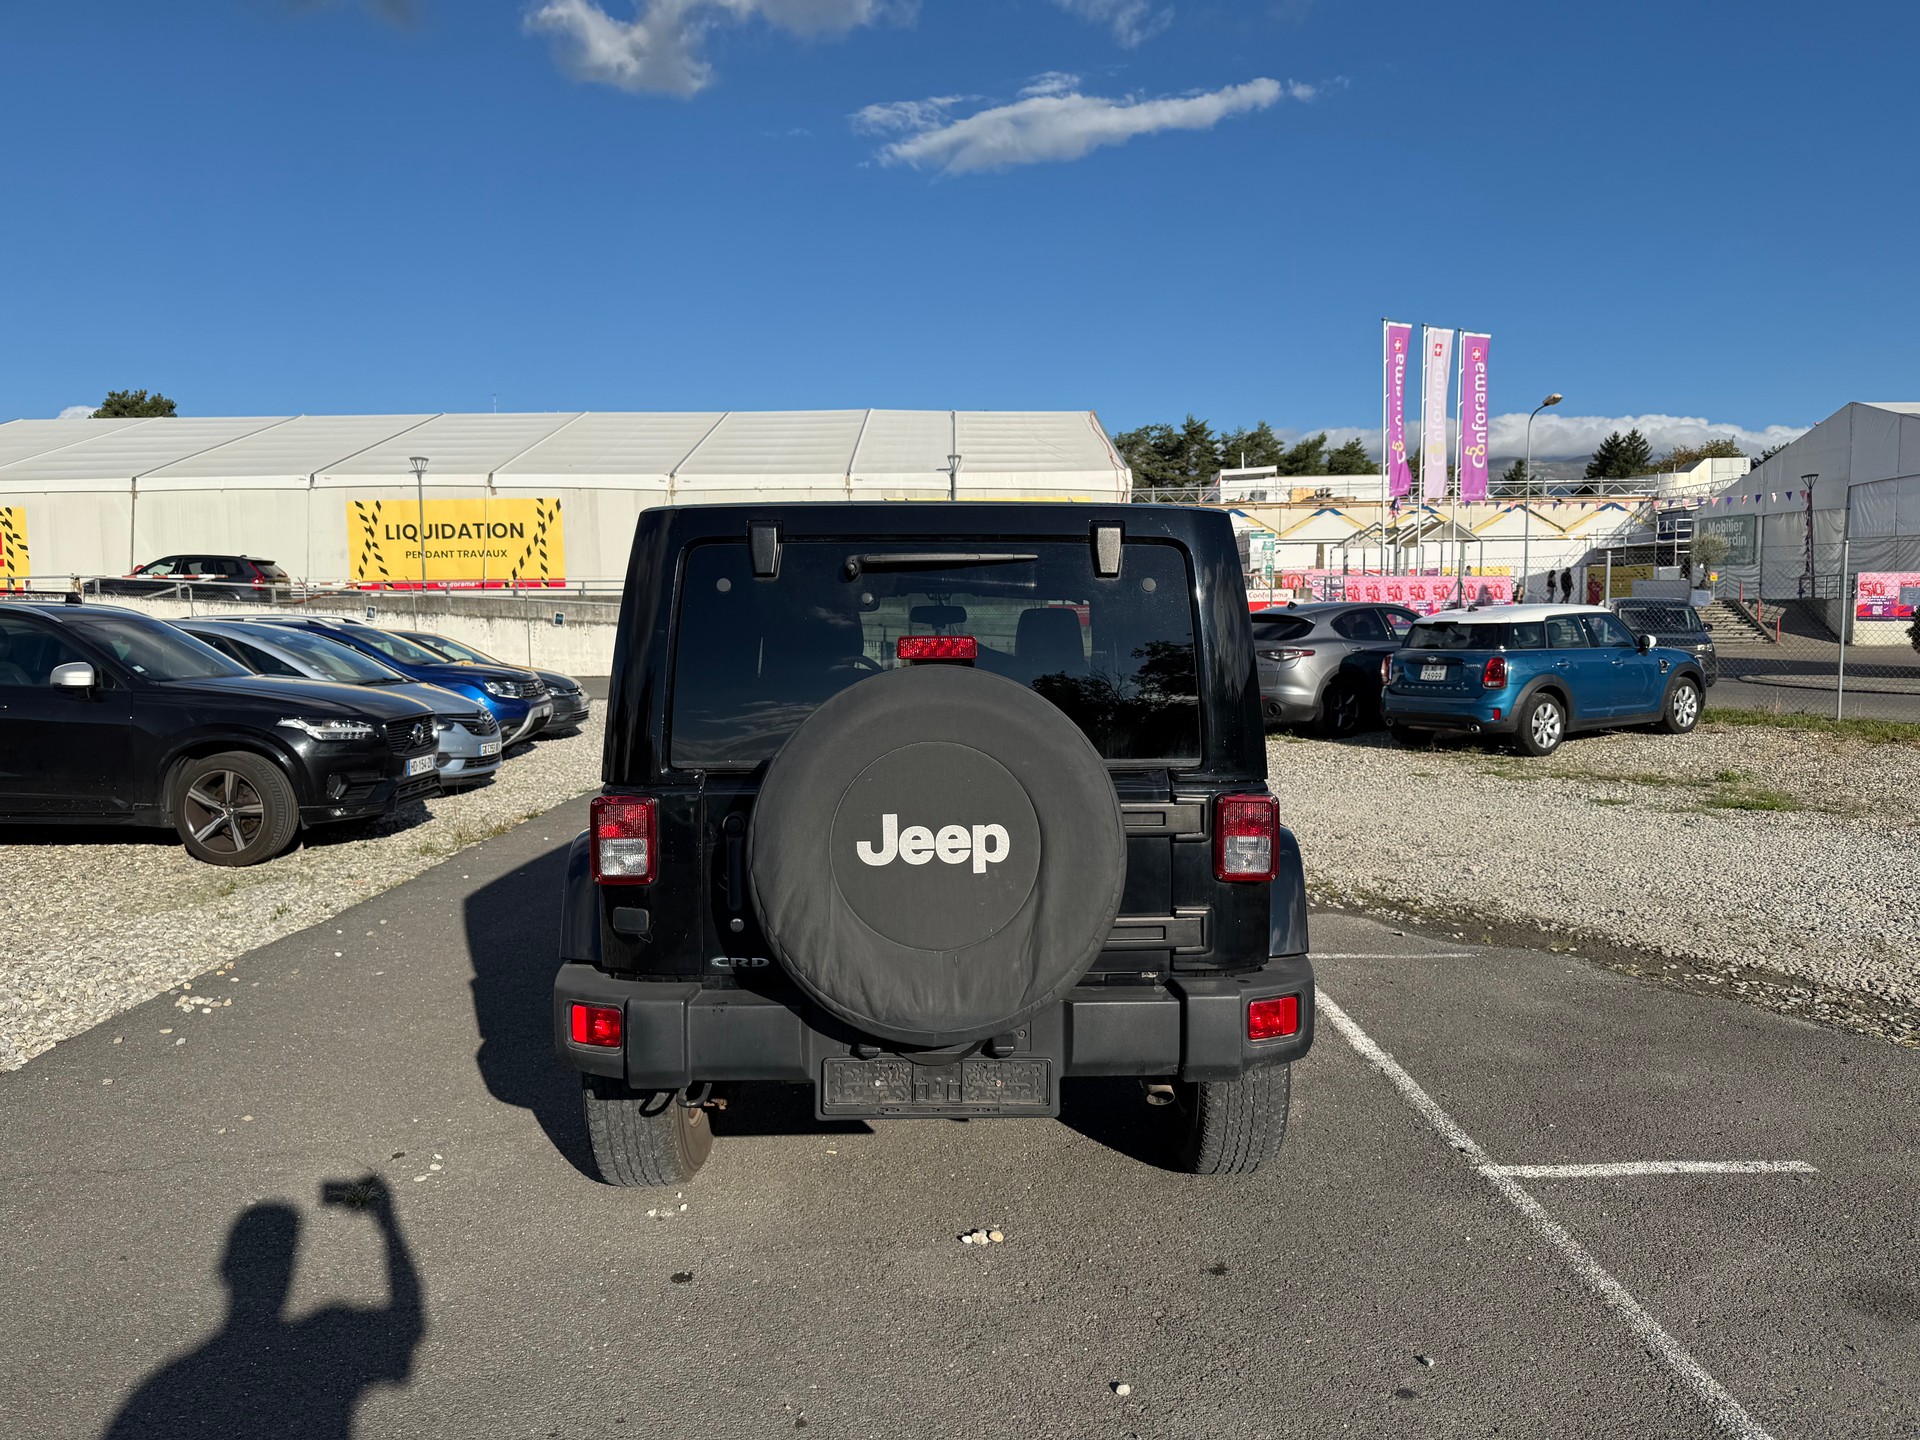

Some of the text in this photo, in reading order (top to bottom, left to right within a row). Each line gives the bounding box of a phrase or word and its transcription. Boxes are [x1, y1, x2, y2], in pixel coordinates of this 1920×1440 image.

[1467, 362, 1487, 468] Conforama
[385, 522, 525, 543] LIQUIDATION
[1707, 518, 1744, 535] Mobilier
[1720, 532, 1747, 547] ardin
[405, 548, 508, 560] PENDANT TRAVAUX
[1248, 591, 1288, 599] Confoama
[1346, 585, 1361, 601] 50
[1365, 584, 1381, 601] 50
[1386, 584, 1403, 601] 50
[1408, 584, 1426, 601] 50
[1433, 584, 1451, 601] 50
[1860, 580, 1885, 596] 50
[856, 813, 1010, 874] Jeep
[711, 957, 770, 968] CRD
